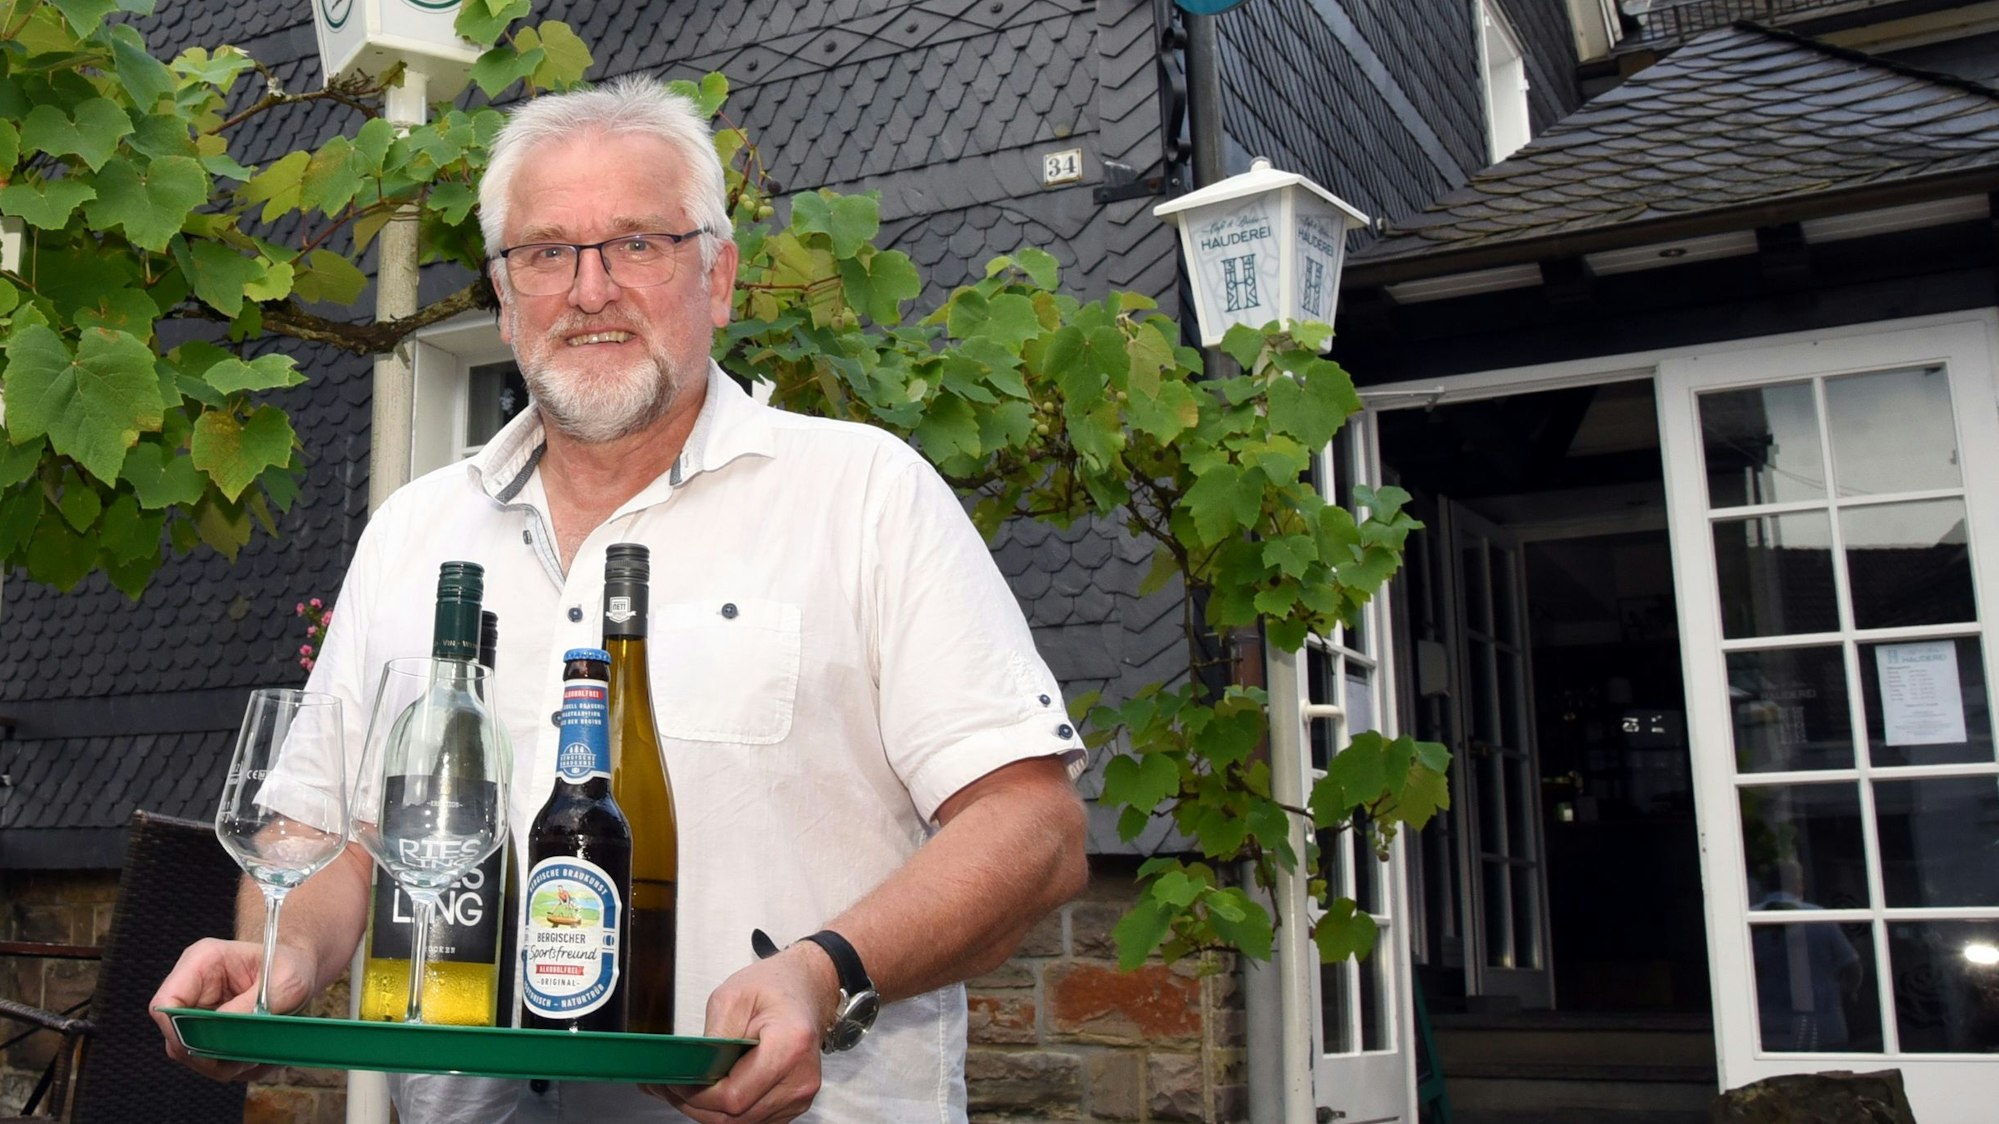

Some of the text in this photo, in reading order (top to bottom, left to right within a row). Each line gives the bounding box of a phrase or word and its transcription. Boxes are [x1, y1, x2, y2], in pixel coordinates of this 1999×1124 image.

[1048, 155, 1077, 177] 34
[1201, 225, 1271, 251] HAUDEREI
[562, 868, 608, 895] BRAUKUNST
[392, 888, 484, 927] LNG
[537, 932, 586, 944] BERGISCHER
[529, 944, 598, 962] Sportsfreund
[539, 965, 578, 974] ALKOHOLFREI
